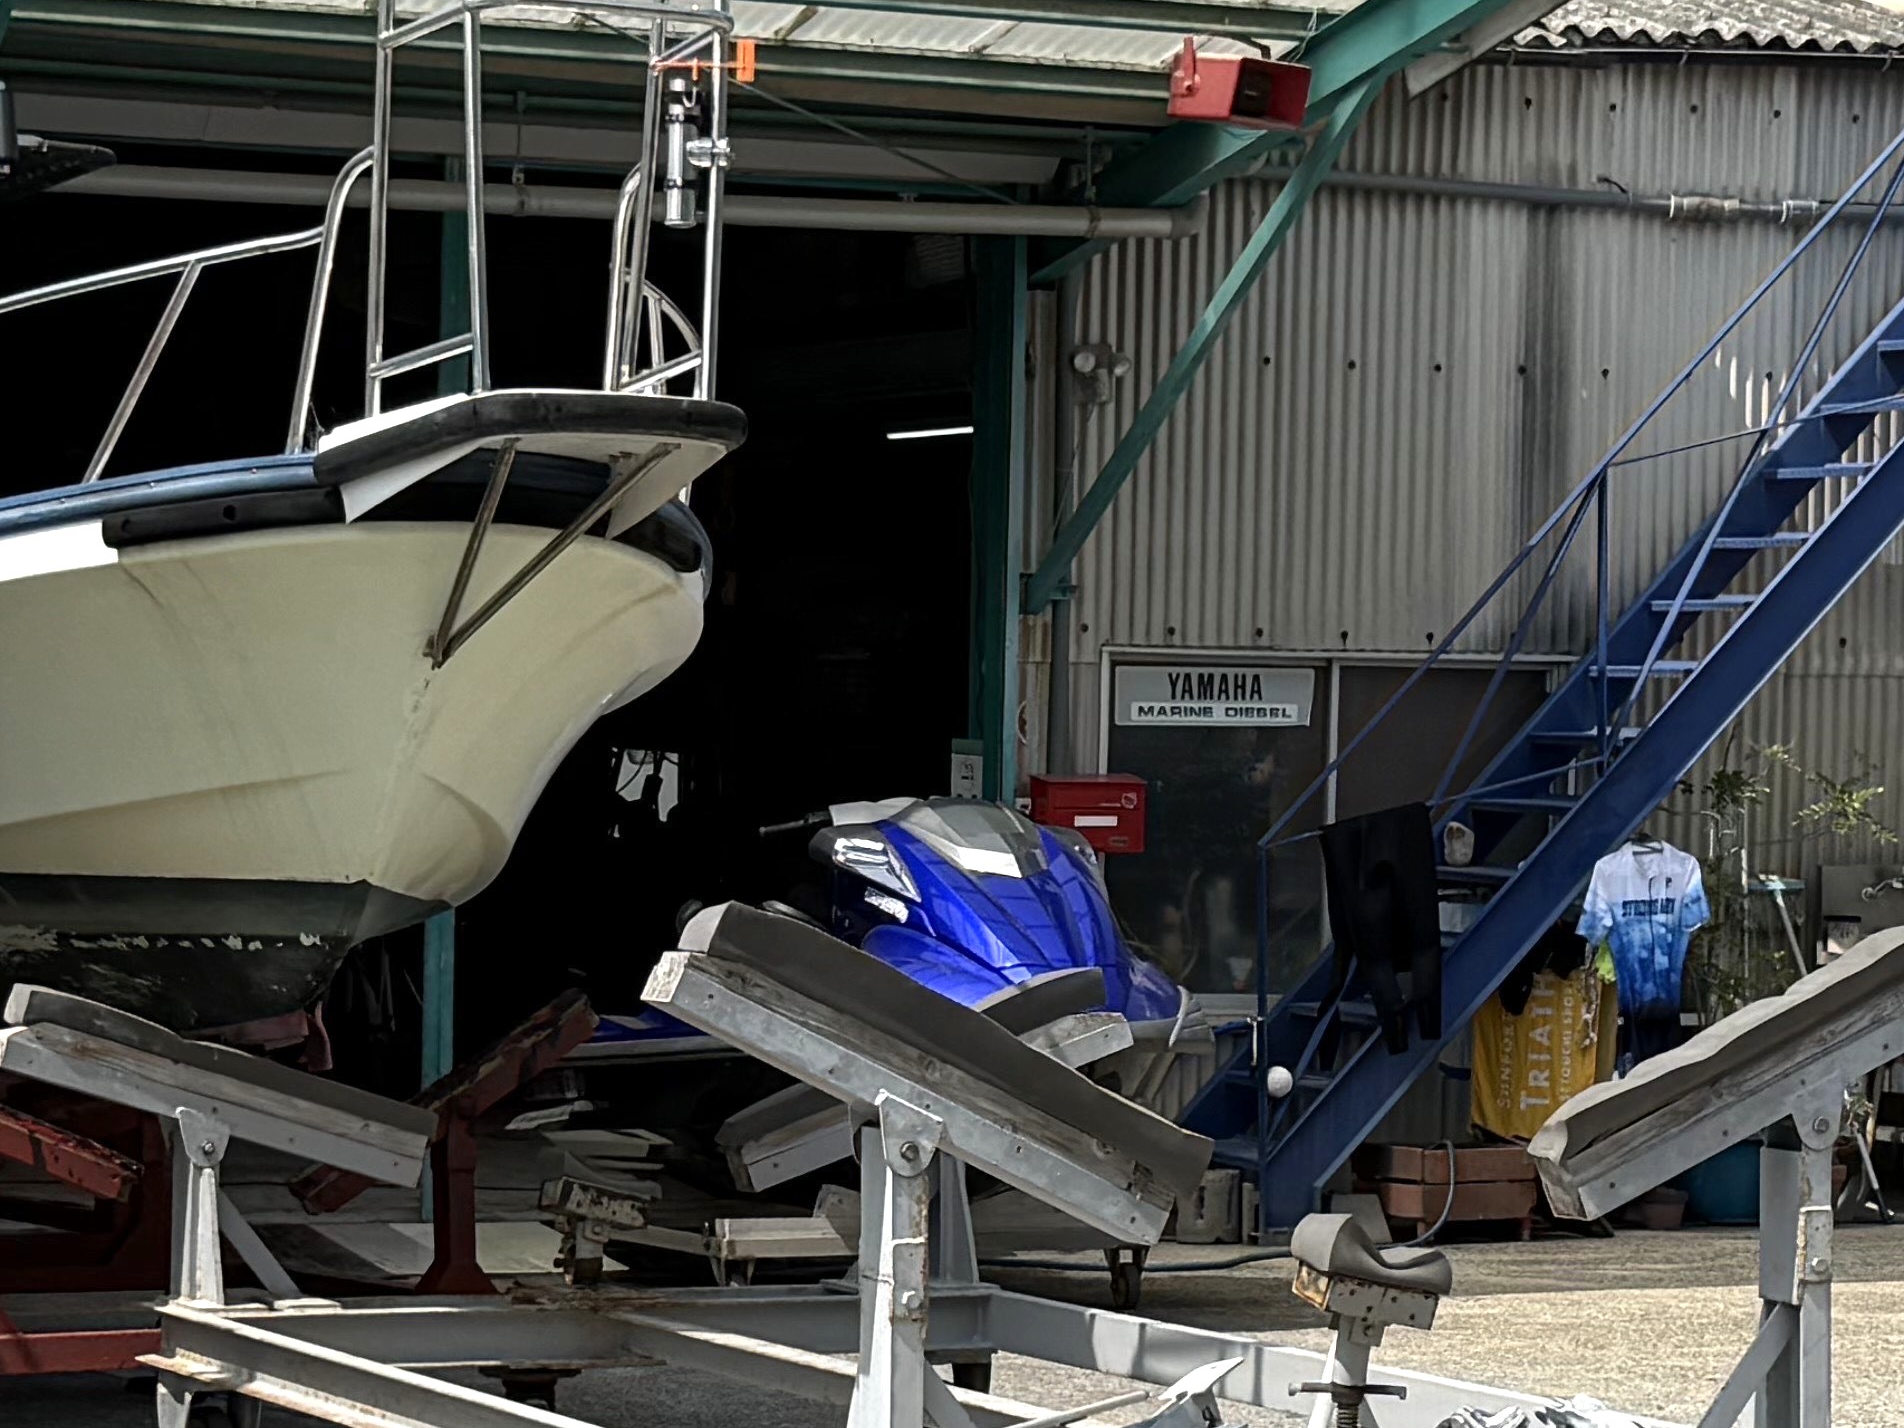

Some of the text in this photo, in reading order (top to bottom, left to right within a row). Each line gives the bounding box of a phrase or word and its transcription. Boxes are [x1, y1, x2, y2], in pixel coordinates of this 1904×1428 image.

[1168, 672, 1263, 701] YAMAHA
[1138, 705, 1292, 719] MARINE DIESEL
